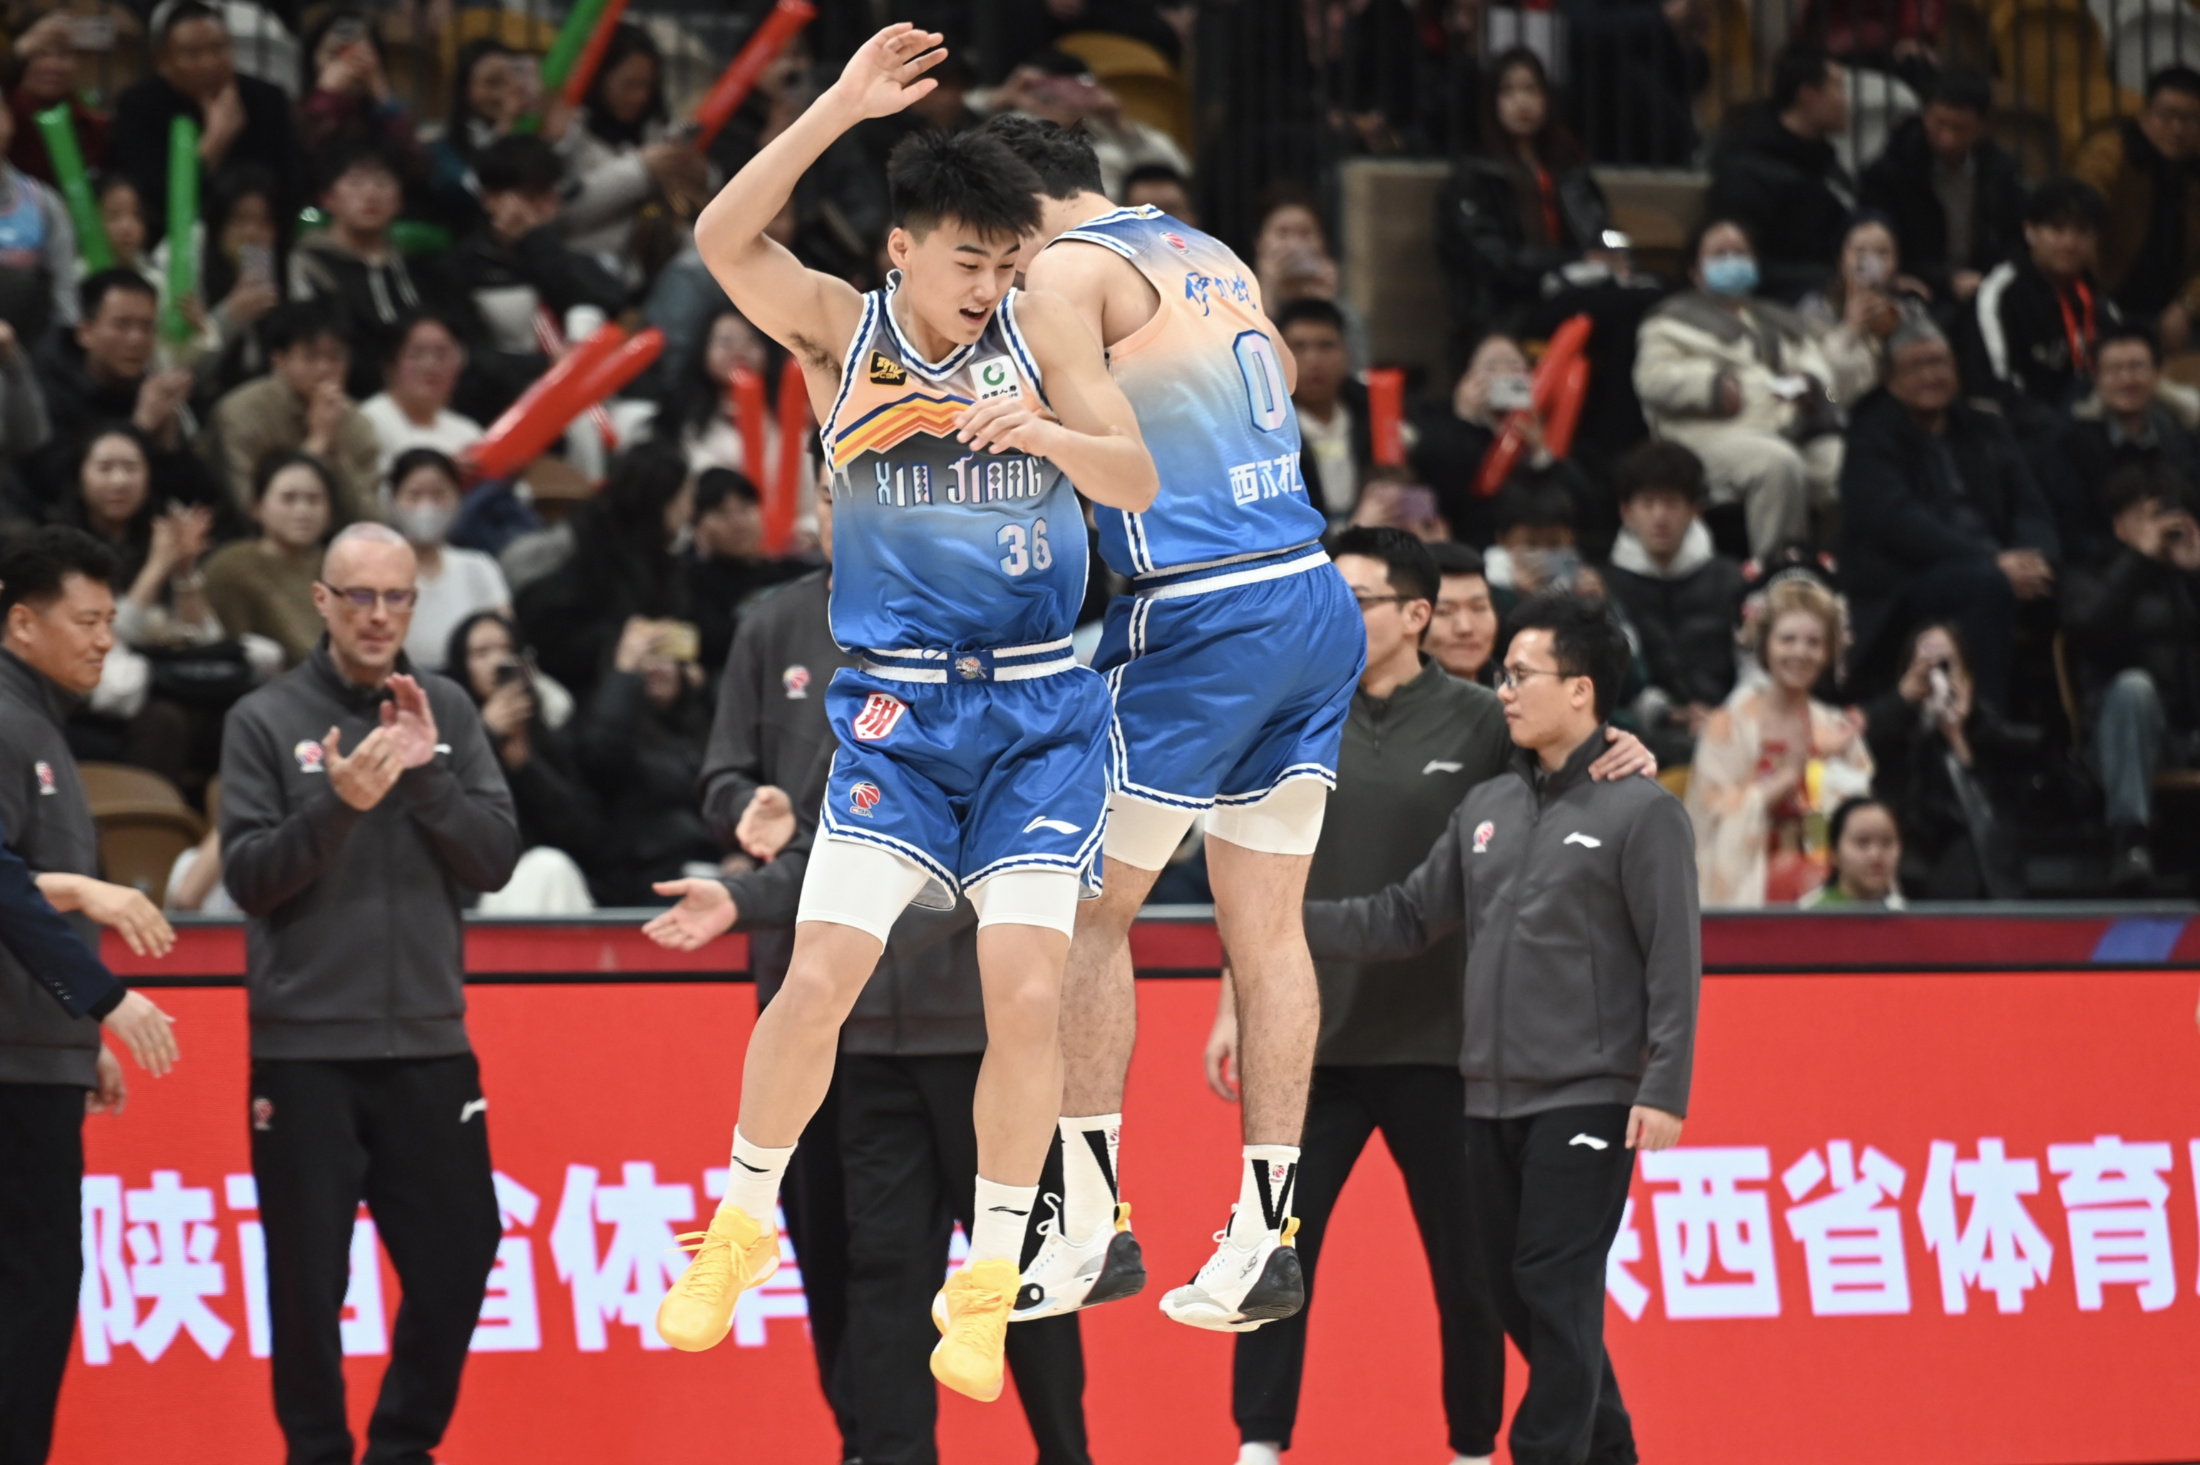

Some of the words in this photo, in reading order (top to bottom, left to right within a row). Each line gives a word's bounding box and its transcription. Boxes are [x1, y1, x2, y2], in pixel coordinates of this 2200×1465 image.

[1232, 329, 1287, 433] 0
[875, 460, 933, 507] XIN
[946, 453, 1043, 505] JIANG
[1228, 451, 1303, 507] 西尔扎
[996, 517, 1052, 576] 36
[1606, 1134, 2200, 1322] 西省体育
